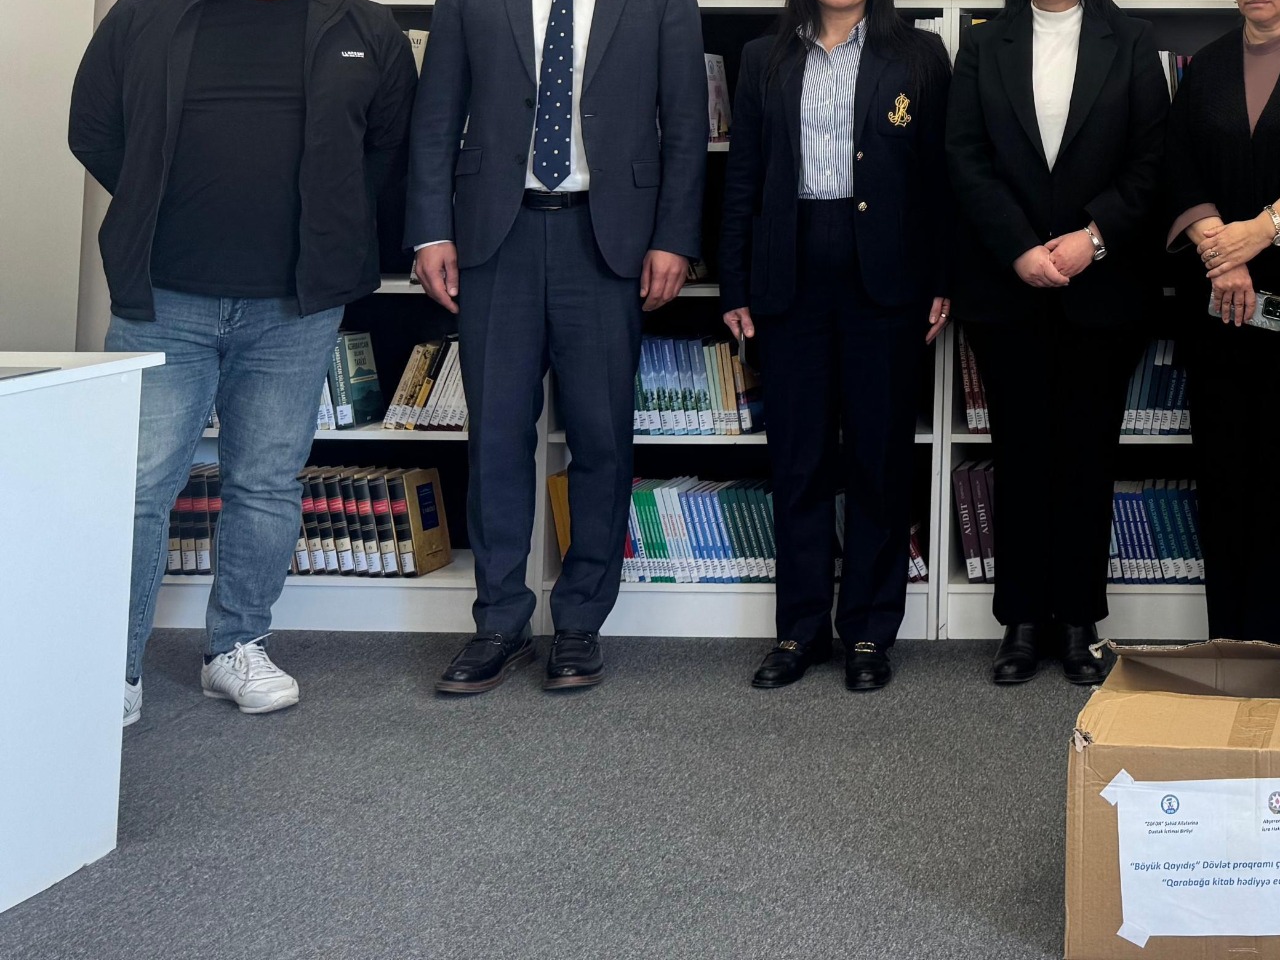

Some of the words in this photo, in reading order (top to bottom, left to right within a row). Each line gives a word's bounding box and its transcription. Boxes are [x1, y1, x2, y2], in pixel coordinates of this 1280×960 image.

[1202, 860, 1231, 870] Dövlət
[1233, 861, 1273, 871] proqramı
[1212, 876, 1235, 886] kitab
[1237, 876, 1271, 888] hədiyyə
